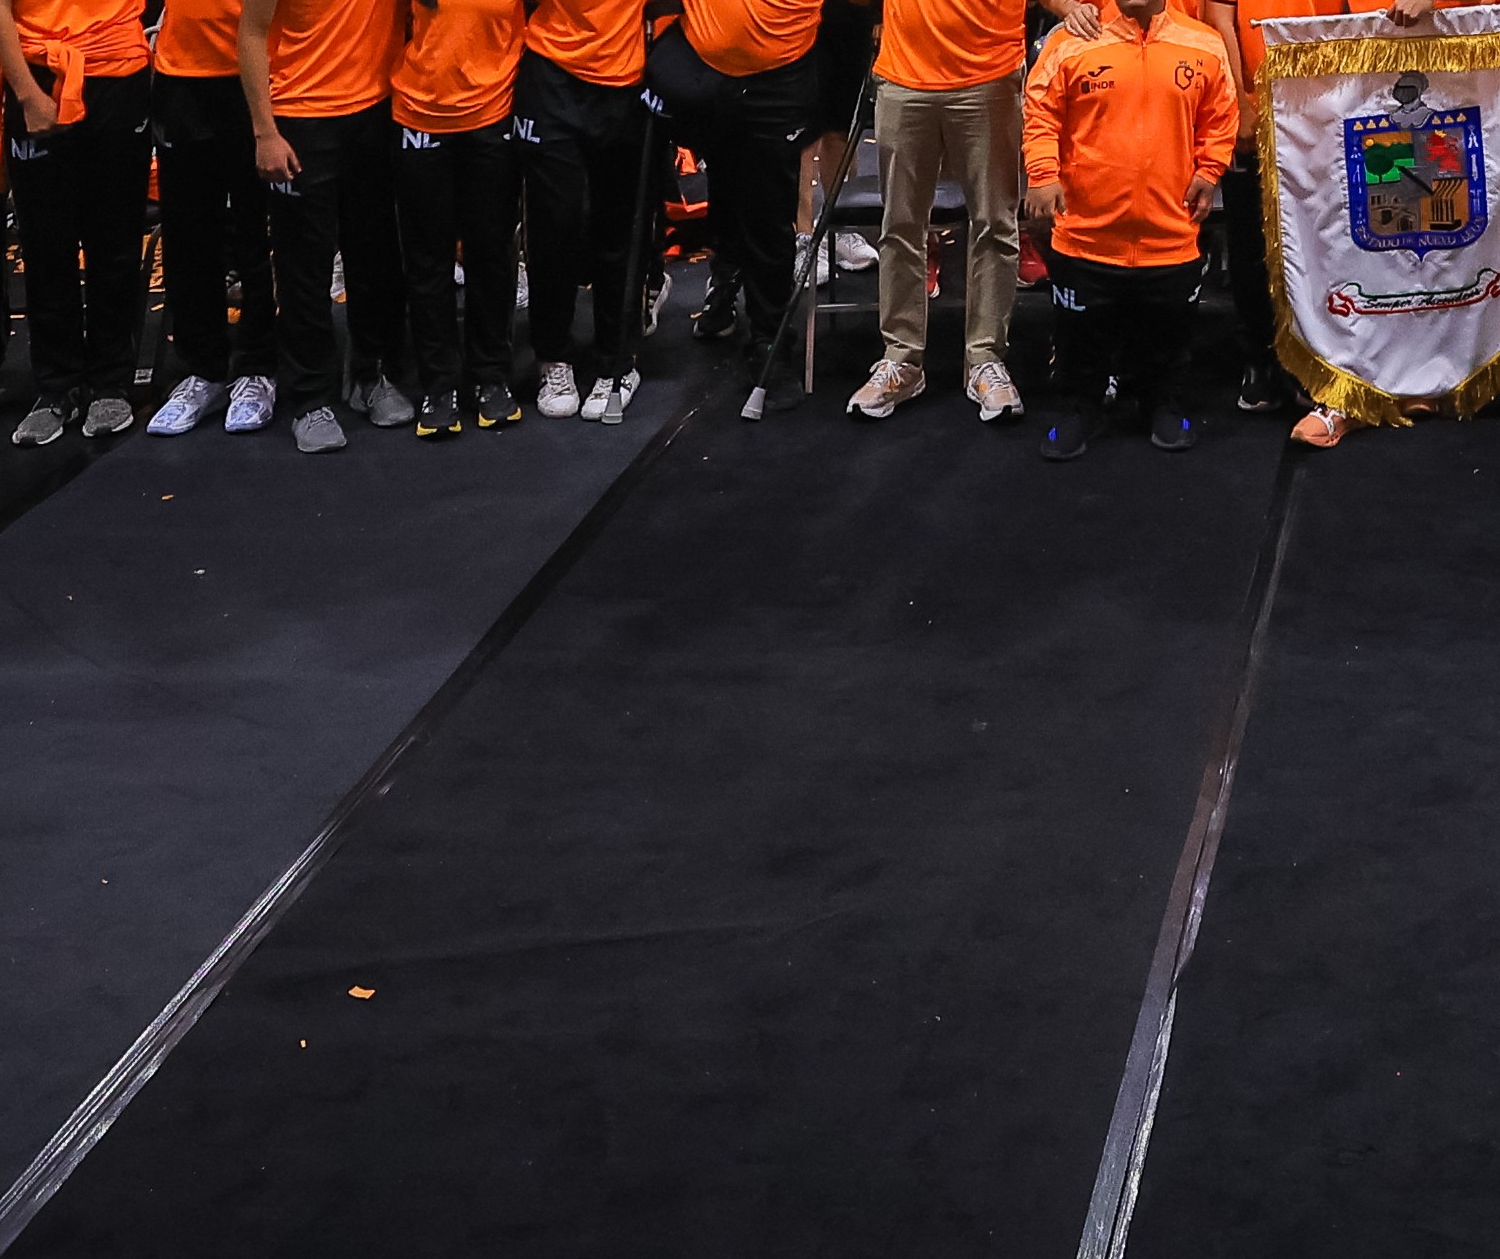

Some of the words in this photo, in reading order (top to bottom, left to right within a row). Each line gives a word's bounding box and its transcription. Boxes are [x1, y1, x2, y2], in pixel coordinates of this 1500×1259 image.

[1090, 80, 1115, 90] INDE
[640, 88, 672, 118] NL
[402, 128, 440, 149] NL
[512, 116, 540, 143] NL
[10, 138, 48, 161] NL
[1052, 284, 1086, 311] NL
